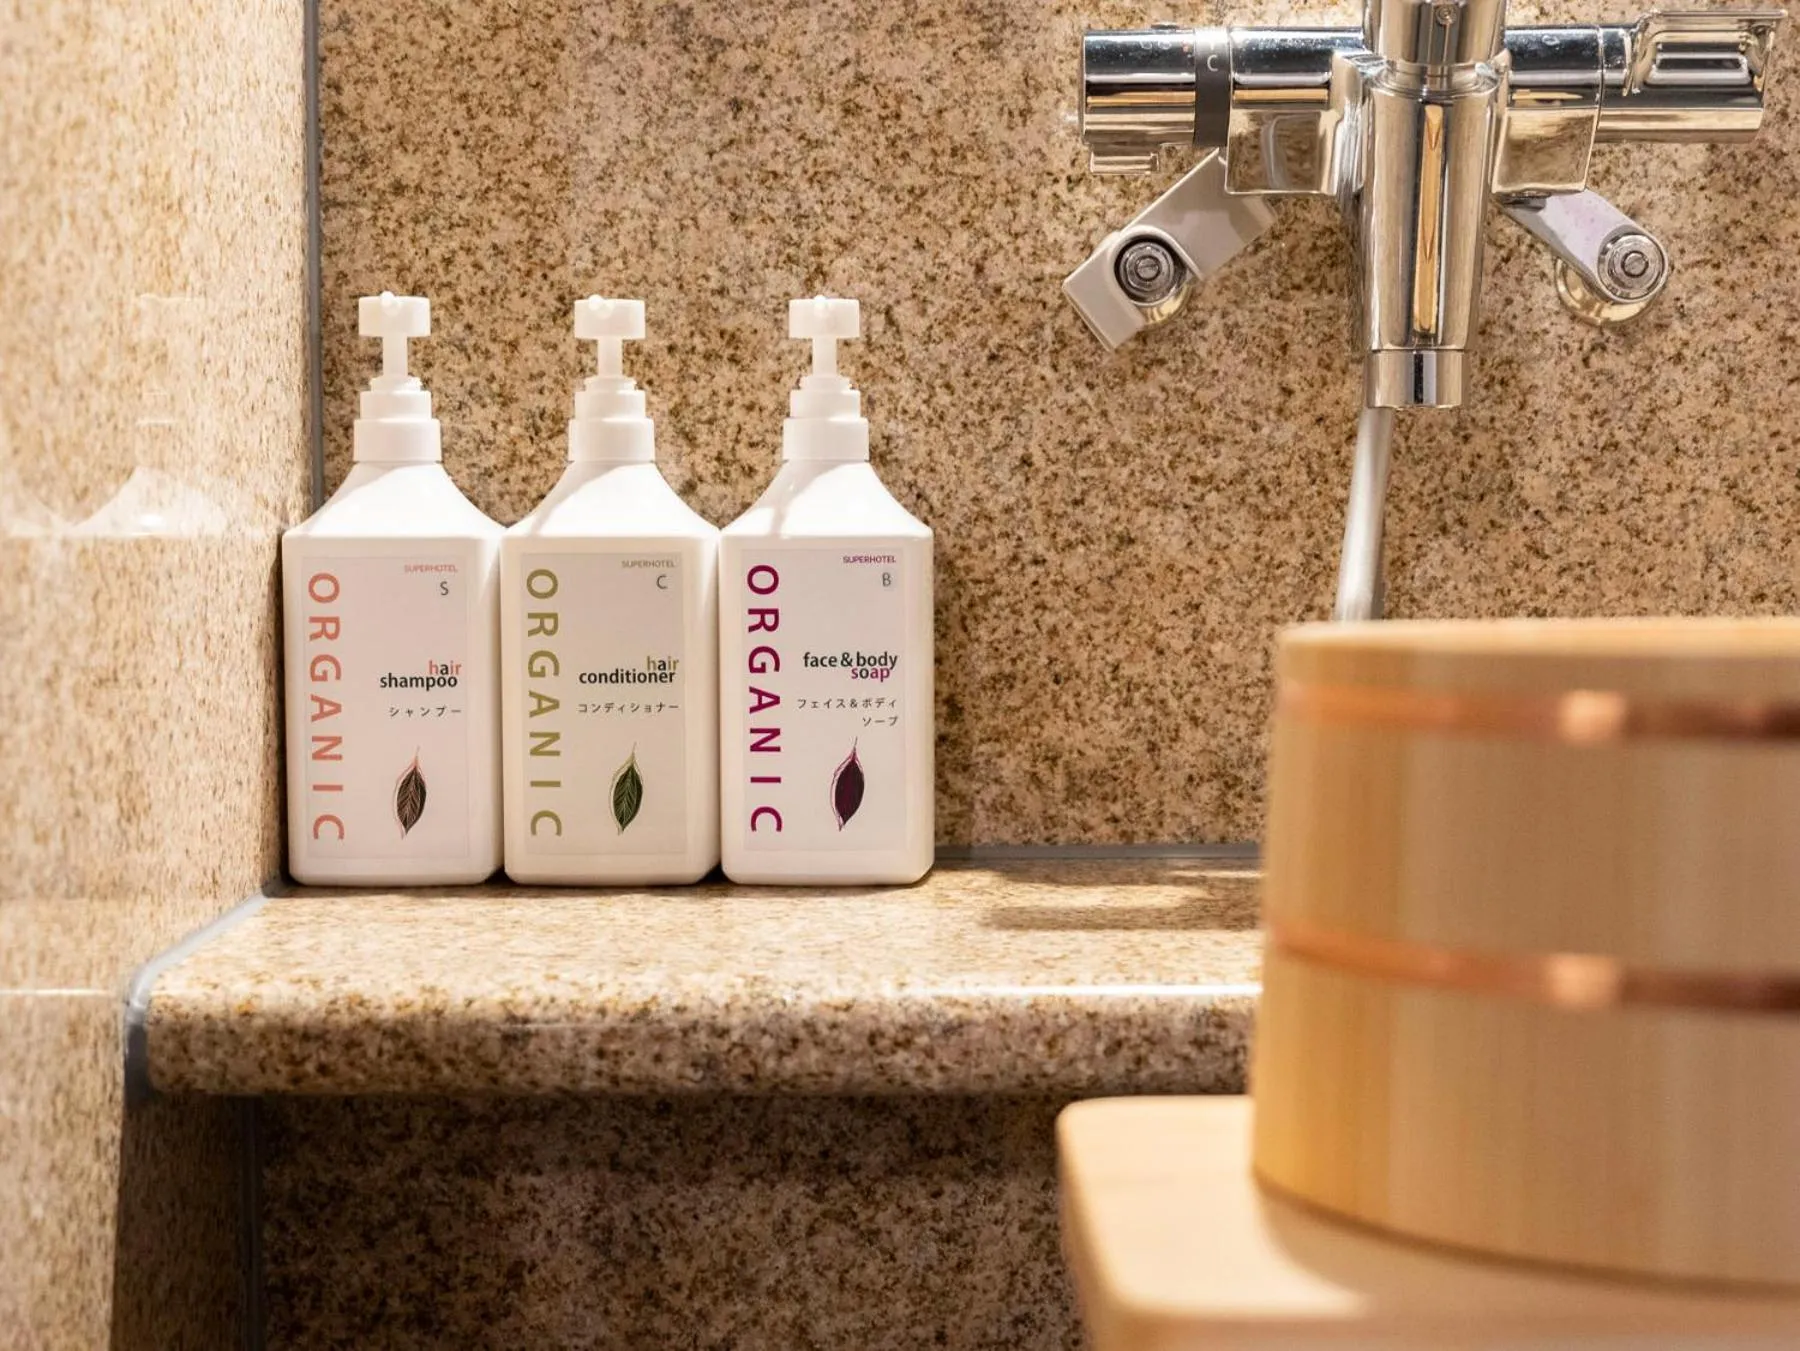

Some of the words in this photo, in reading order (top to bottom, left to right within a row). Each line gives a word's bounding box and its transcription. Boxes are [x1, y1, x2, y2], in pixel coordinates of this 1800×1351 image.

[621, 559, 675, 568] SUPERHOTEL
[842, 555, 896, 563] SUPERHOTEL
[404, 564, 458, 573] SUPERHOTEL
[656, 575, 668, 589] C
[882, 572, 892, 587] B
[440, 581, 449, 596] S
[429, 660, 462, 675] hair
[646, 656, 679, 671] hair
[379, 672, 458, 692] shampoo
[578, 668, 675, 684] conditioner
[851, 667, 890, 682] soap
[526, 569, 562, 836] ORGANIC
[747, 565, 783, 832] ORGANIC
[308, 573, 345, 840] ORGANIC
[389, 704, 462, 717] シャンプー
[578, 702, 679, 713] コンディショナー
[862, 716, 898, 727] ソープ
